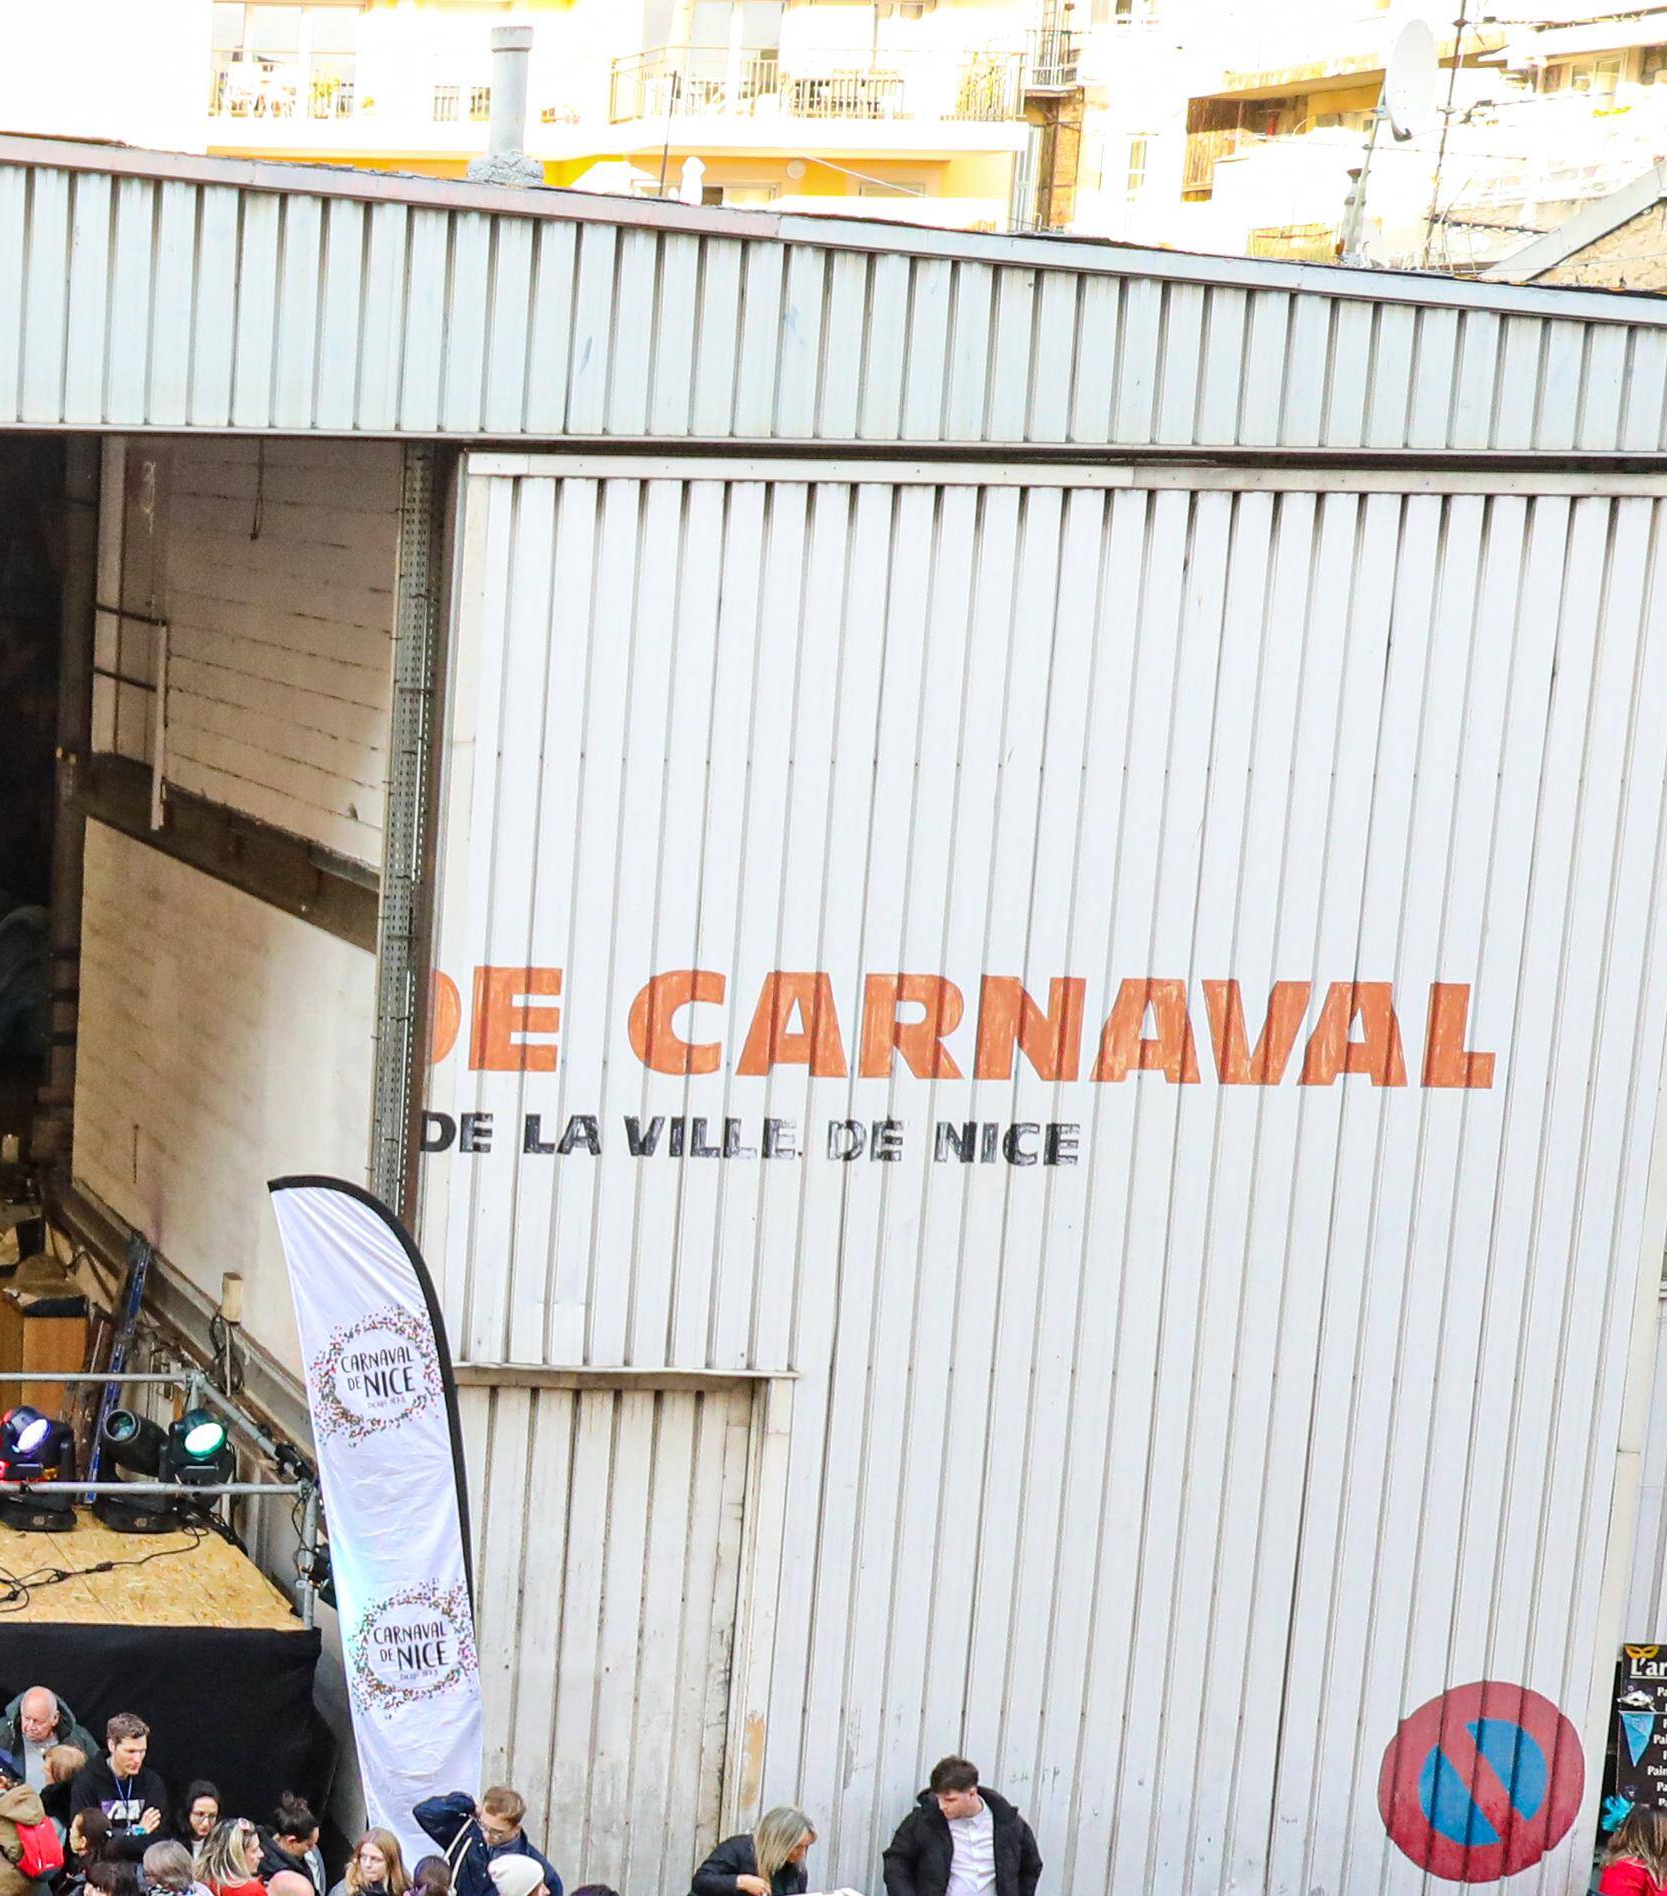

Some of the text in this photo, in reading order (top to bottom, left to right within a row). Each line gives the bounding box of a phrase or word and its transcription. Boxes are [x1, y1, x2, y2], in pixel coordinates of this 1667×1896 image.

[626, 968, 1496, 1089] CARNAVAL
[419, 1110, 494, 1153] DE
[523, 1113, 602, 1156] LA
[826, 1117, 905, 1162] DE
[933, 1120, 1081, 1166] NICE
[340, 1346, 414, 1374] CARNAVAL
[347, 1366, 417, 1398] DE NICE
[373, 1620, 448, 1645] CARNAVAL
[379, 1640, 450, 1670] DE NICE
